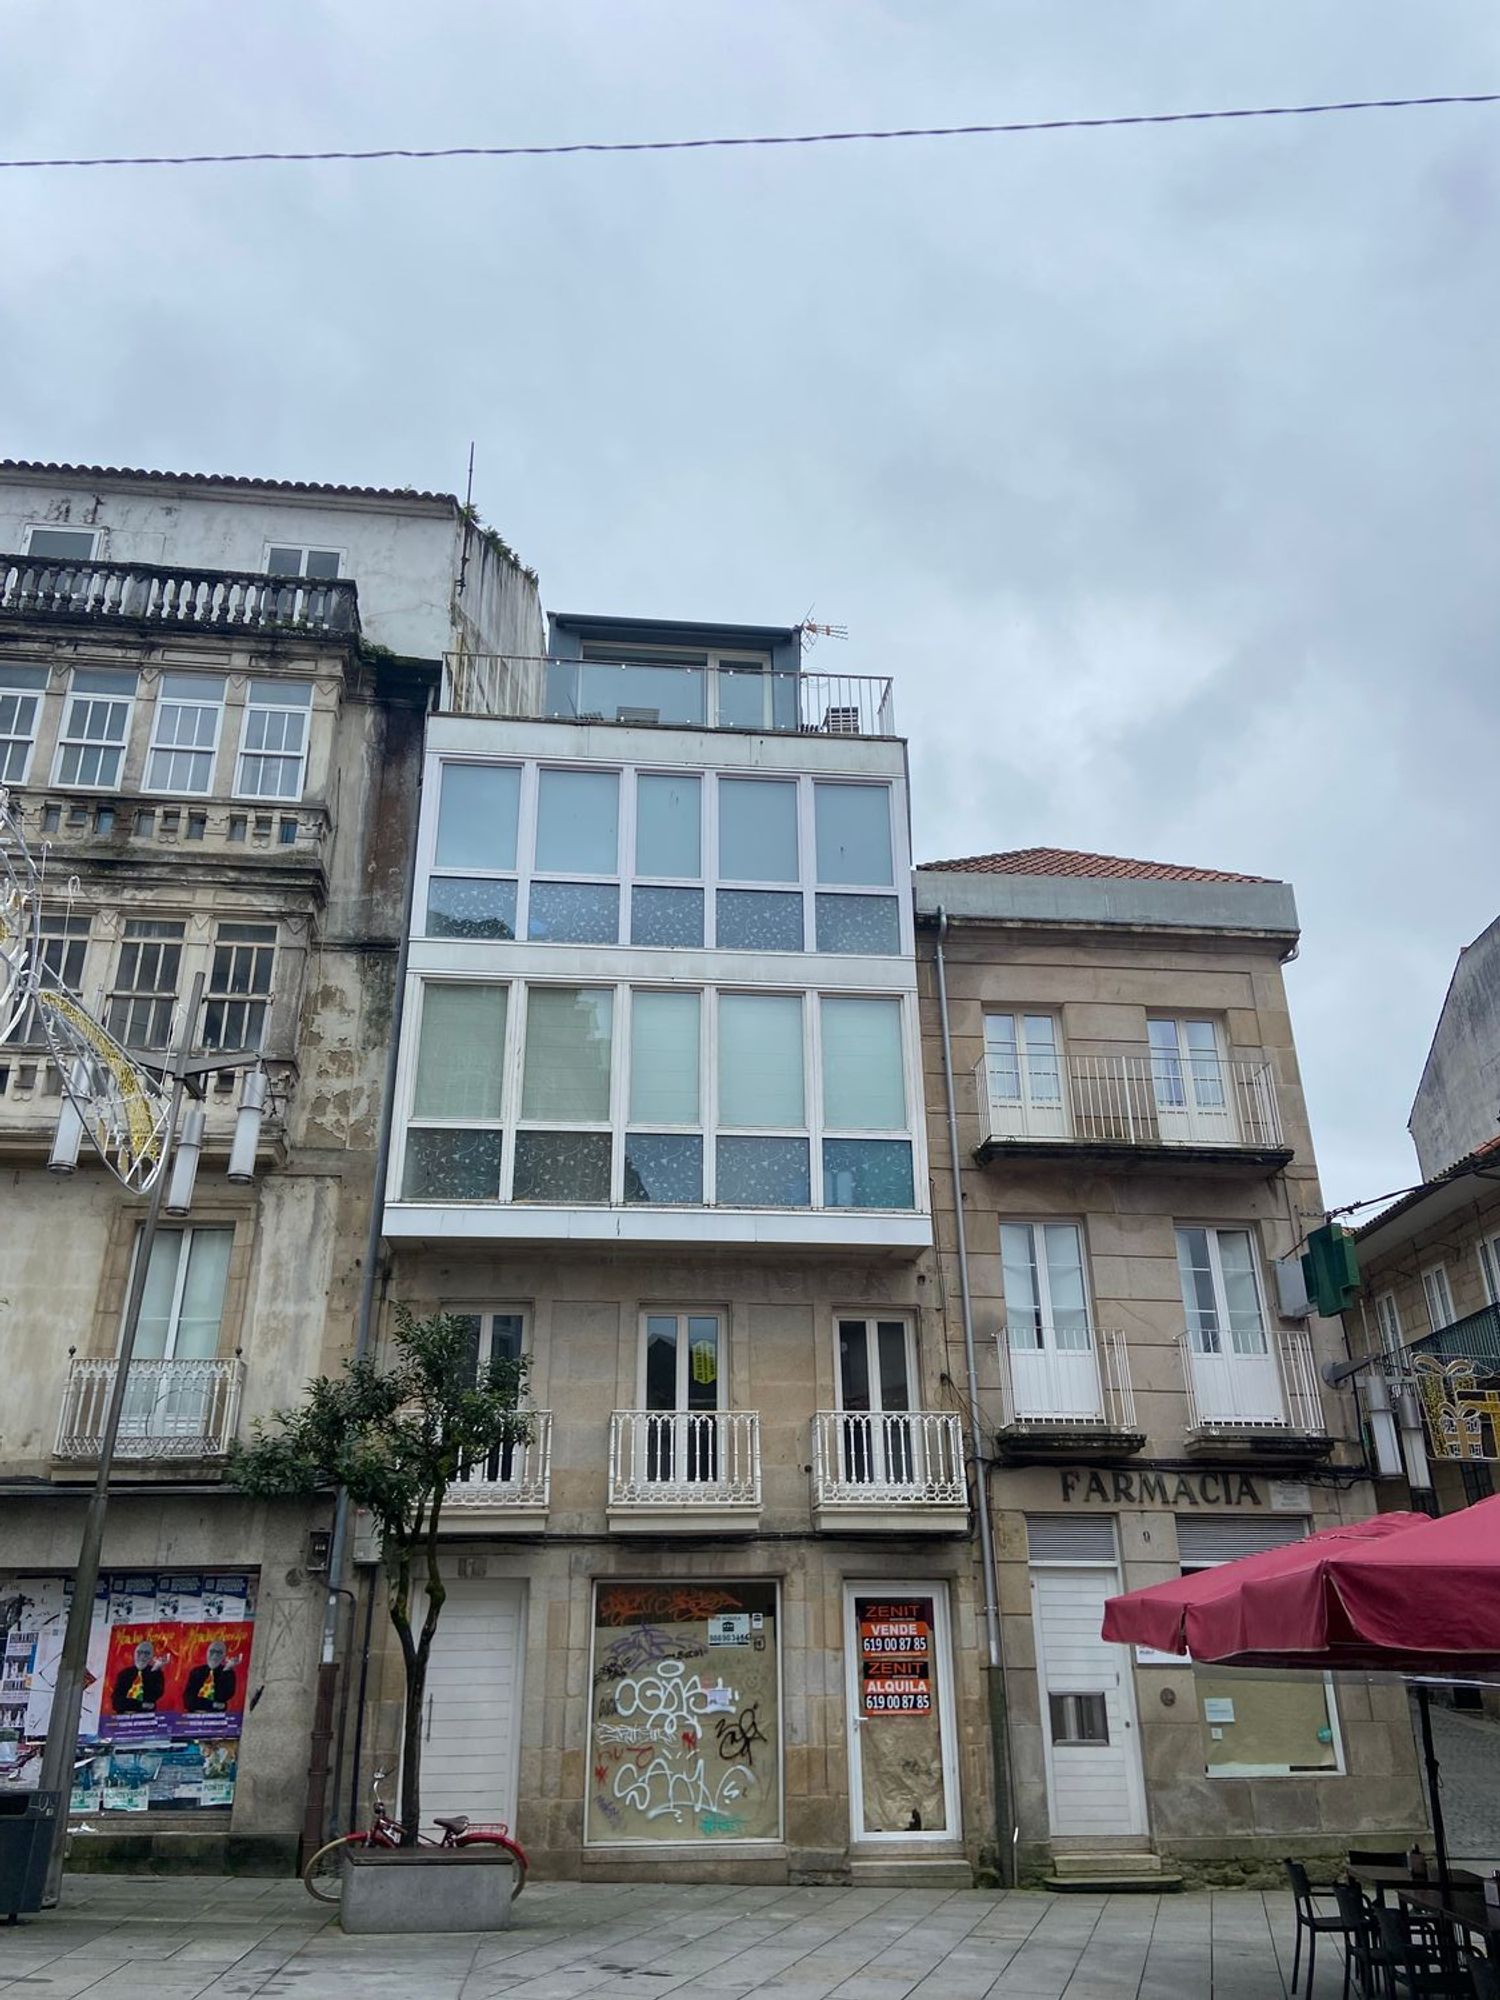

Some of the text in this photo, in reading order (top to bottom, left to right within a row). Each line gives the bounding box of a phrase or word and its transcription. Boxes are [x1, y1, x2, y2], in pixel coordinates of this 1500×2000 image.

[1060, 1471, 1262, 1506] FARMACIA
[865, 1605, 920, 1617] ZENIT
[870, 1624, 917, 1636] VENDE
[863, 1637, 927, 1652] 619 00 87 85
[868, 1662, 924, 1674] ZENIT
[866, 1681, 927, 1694] ALQUILA
[866, 1695, 930, 1709] 619 00 87 85
